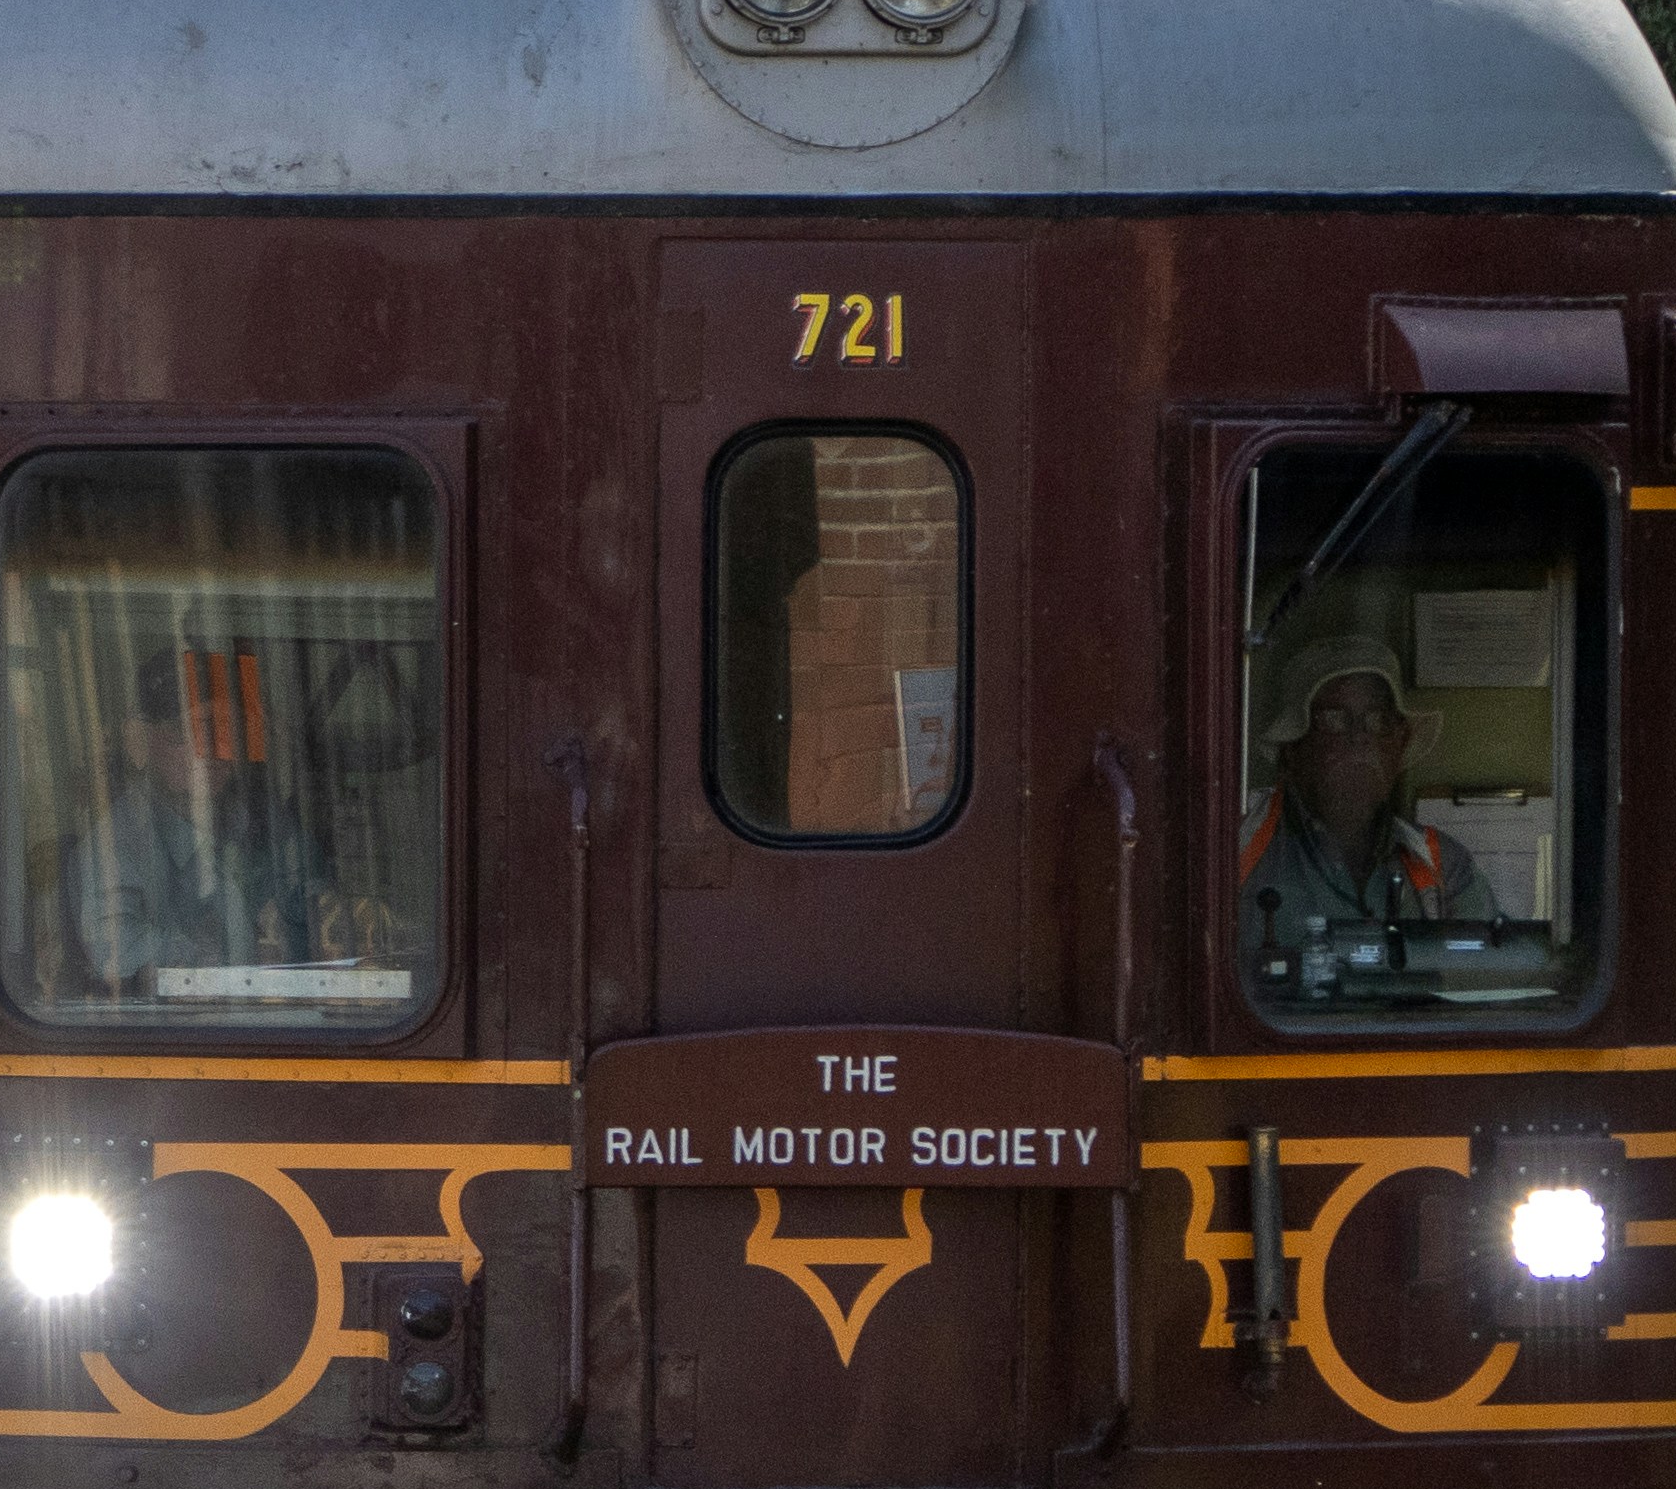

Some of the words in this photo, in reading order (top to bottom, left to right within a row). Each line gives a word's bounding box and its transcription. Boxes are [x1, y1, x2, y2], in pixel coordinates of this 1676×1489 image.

[792, 293, 903, 365] 721
[815, 1055, 899, 1093] THE
[605, 1127, 704, 1165] RAIL
[733, 1126, 887, 1166] MOTOR
[911, 1126, 1099, 1167] SOCIETY
